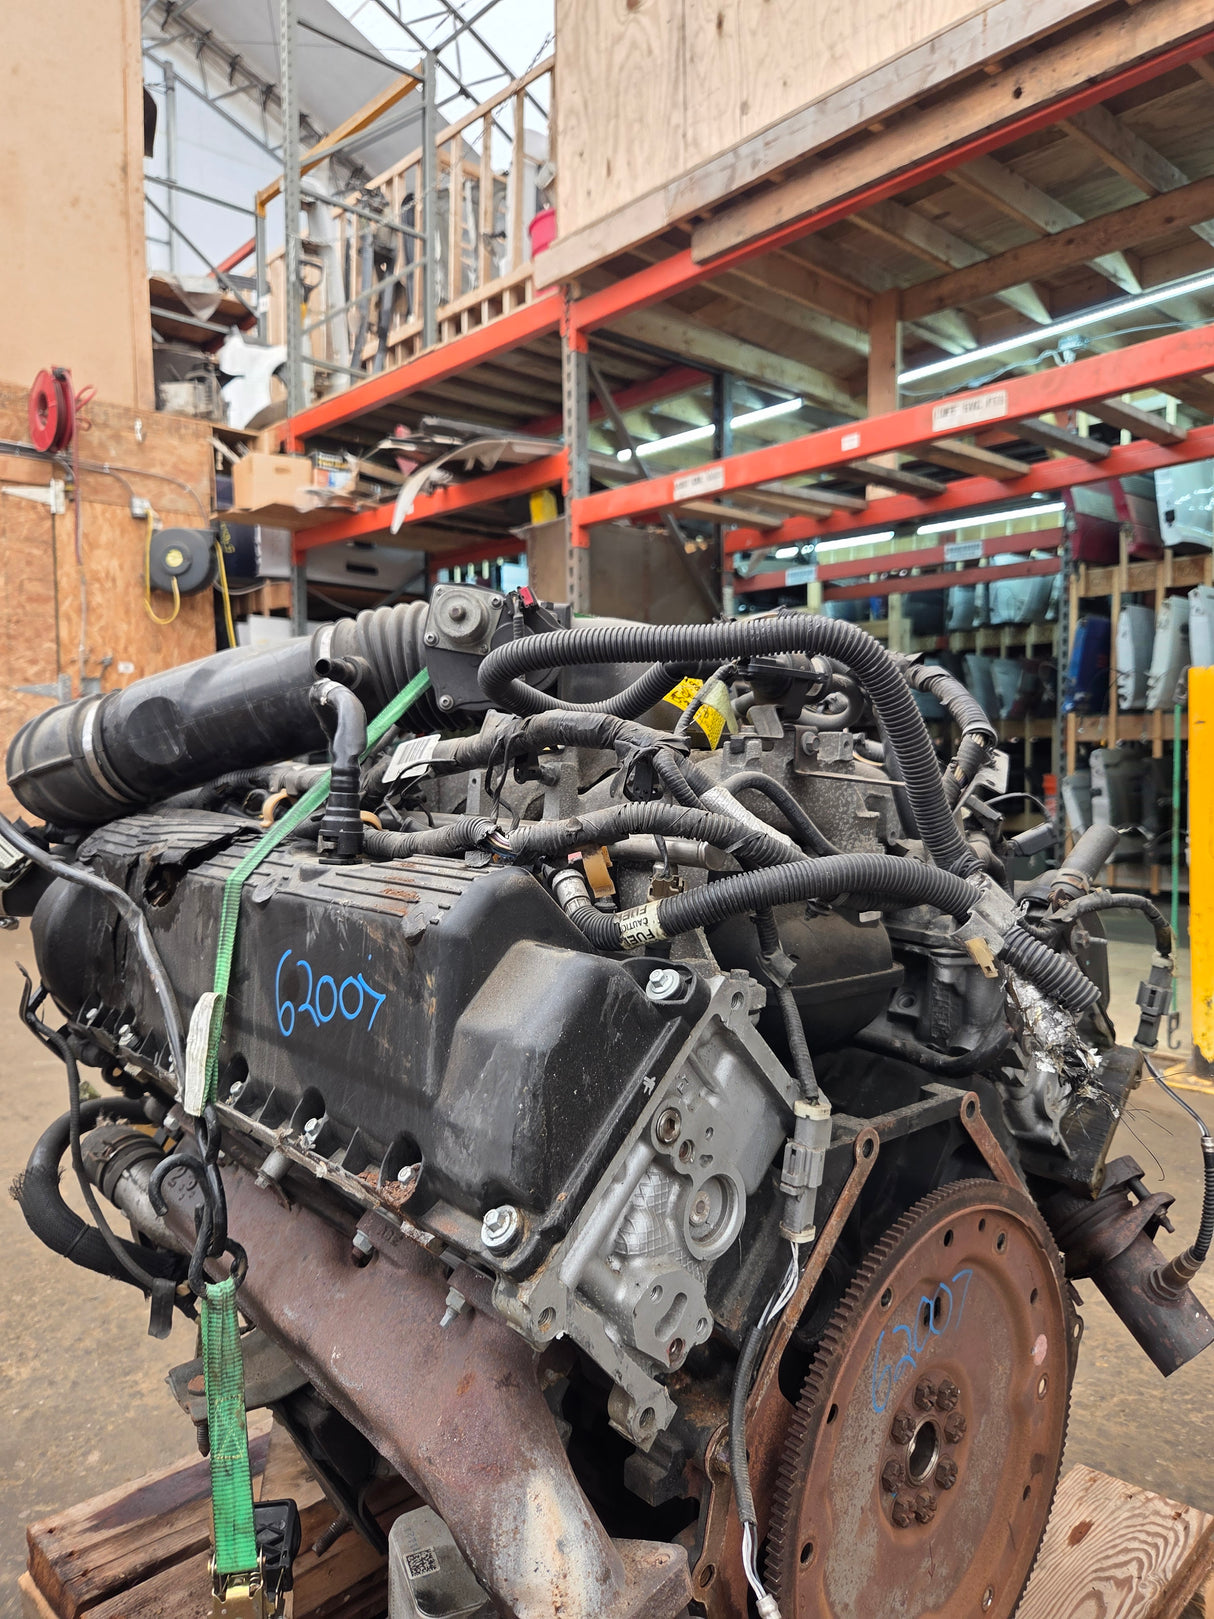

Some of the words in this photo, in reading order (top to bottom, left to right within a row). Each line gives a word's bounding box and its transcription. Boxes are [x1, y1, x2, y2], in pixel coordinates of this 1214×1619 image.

[619, 917, 649, 934] CAUTIO
[275, 949, 387, 1037] 62007
[871, 1269, 974, 1414] 62007
